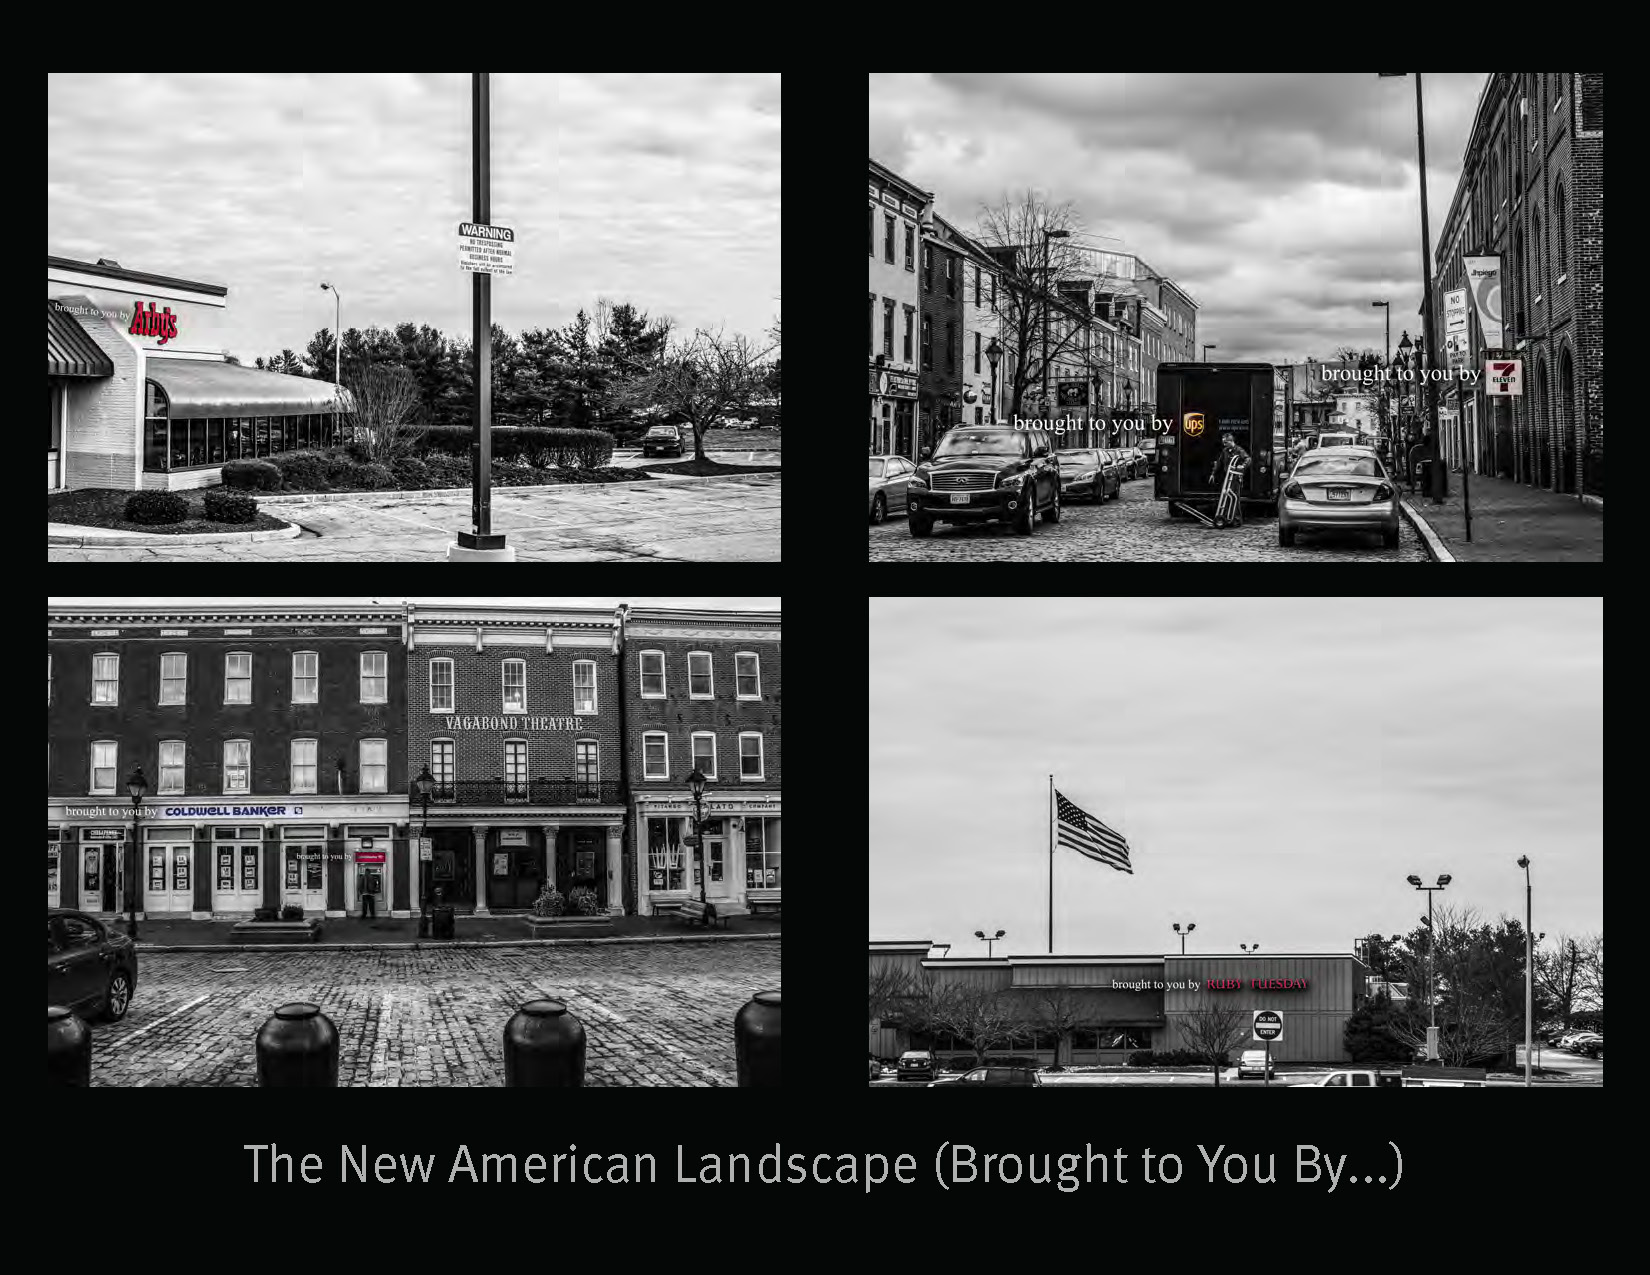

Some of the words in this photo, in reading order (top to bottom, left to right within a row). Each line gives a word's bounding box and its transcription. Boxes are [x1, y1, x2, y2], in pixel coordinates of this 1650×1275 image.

[461, 224, 511, 240] WARNING
[1450, 295, 1460, 304] NO
[1446, 306, 1466, 318] STOPPING
[129, 301, 178, 345] Arby's
[1185, 418, 1204, 433] ups
[445, 716, 518, 731] VAGABOND
[521, 716, 583, 731] THEATRE
[1206, 978, 1244, 989] RUBY
[1251, 977, 1309, 989] TUESDAY
